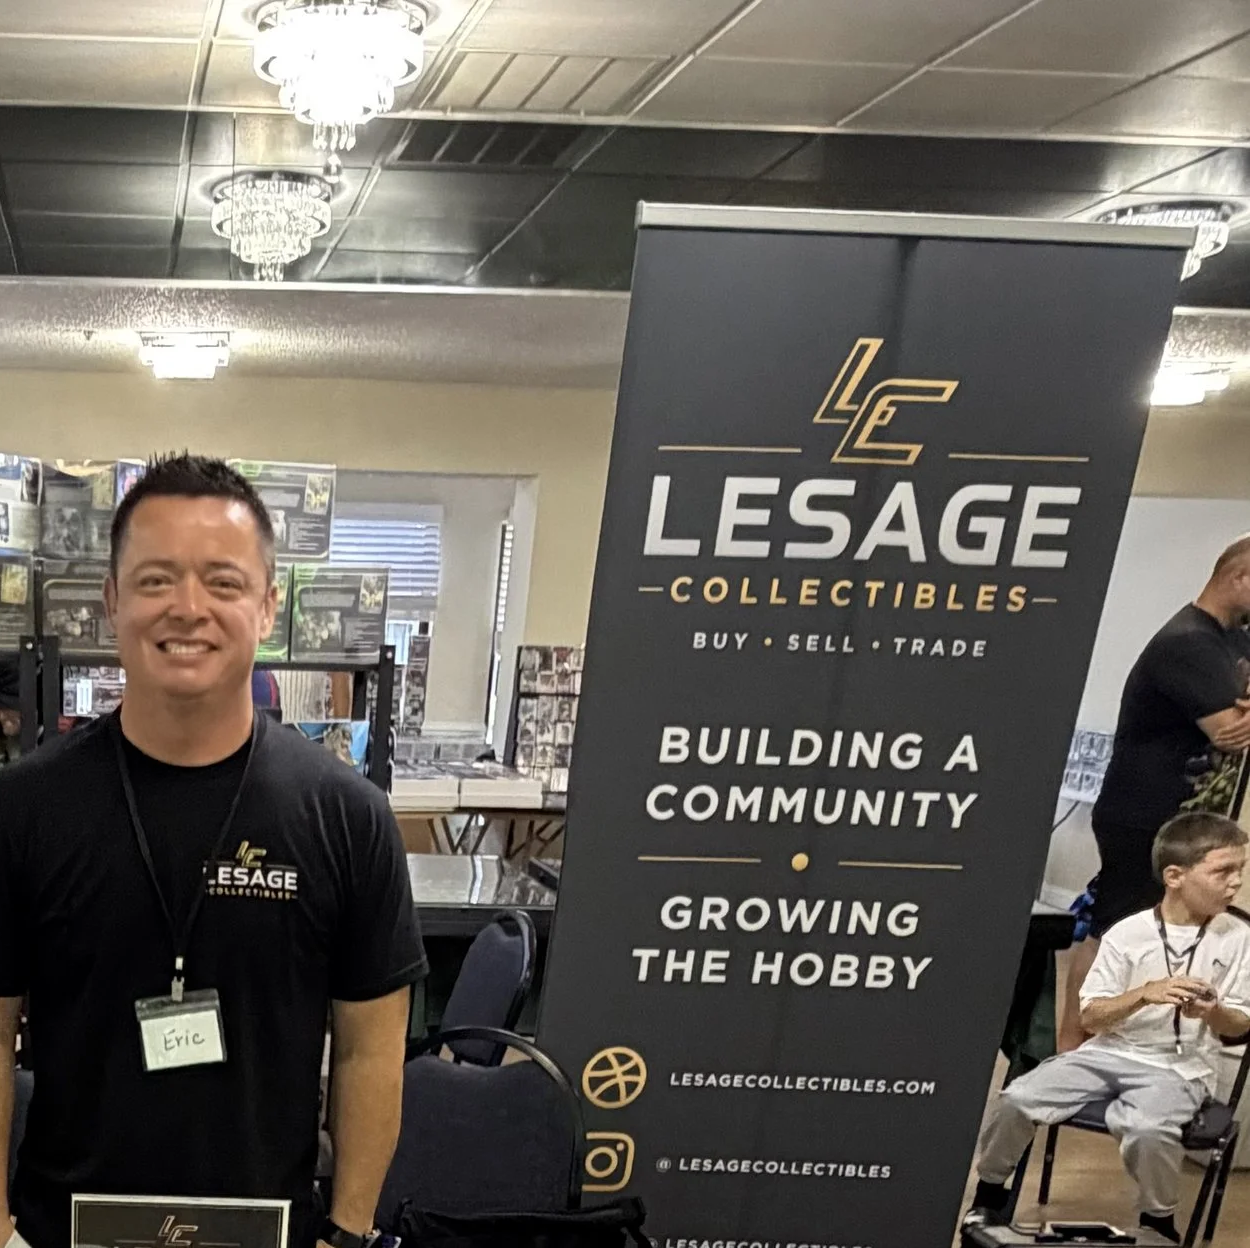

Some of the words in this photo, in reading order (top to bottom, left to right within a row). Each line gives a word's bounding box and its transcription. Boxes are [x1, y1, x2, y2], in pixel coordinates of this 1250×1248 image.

[644, 475, 1081, 567] LESAGE
[671, 576, 1026, 611] COLLECTIBLES
[693, 632, 747, 649] BUY
[788, 634, 853, 652] SELL
[894, 638, 986, 657] TRADE
[660, 727, 922, 769] BUILDING
[944, 735, 977, 771] A
[647, 784, 977, 828] COMMUNITY
[661, 896, 918, 936] GROWING
[633, 949, 729, 982] THE
[752, 952, 932, 989] HOBBY
[163, 1030, 206, 1052] Eric
[671, 1073, 935, 1094] LESAGECOLLECTIBLES.COM
[680, 1158, 890, 1178] LESAGECOLLECTIBLES
